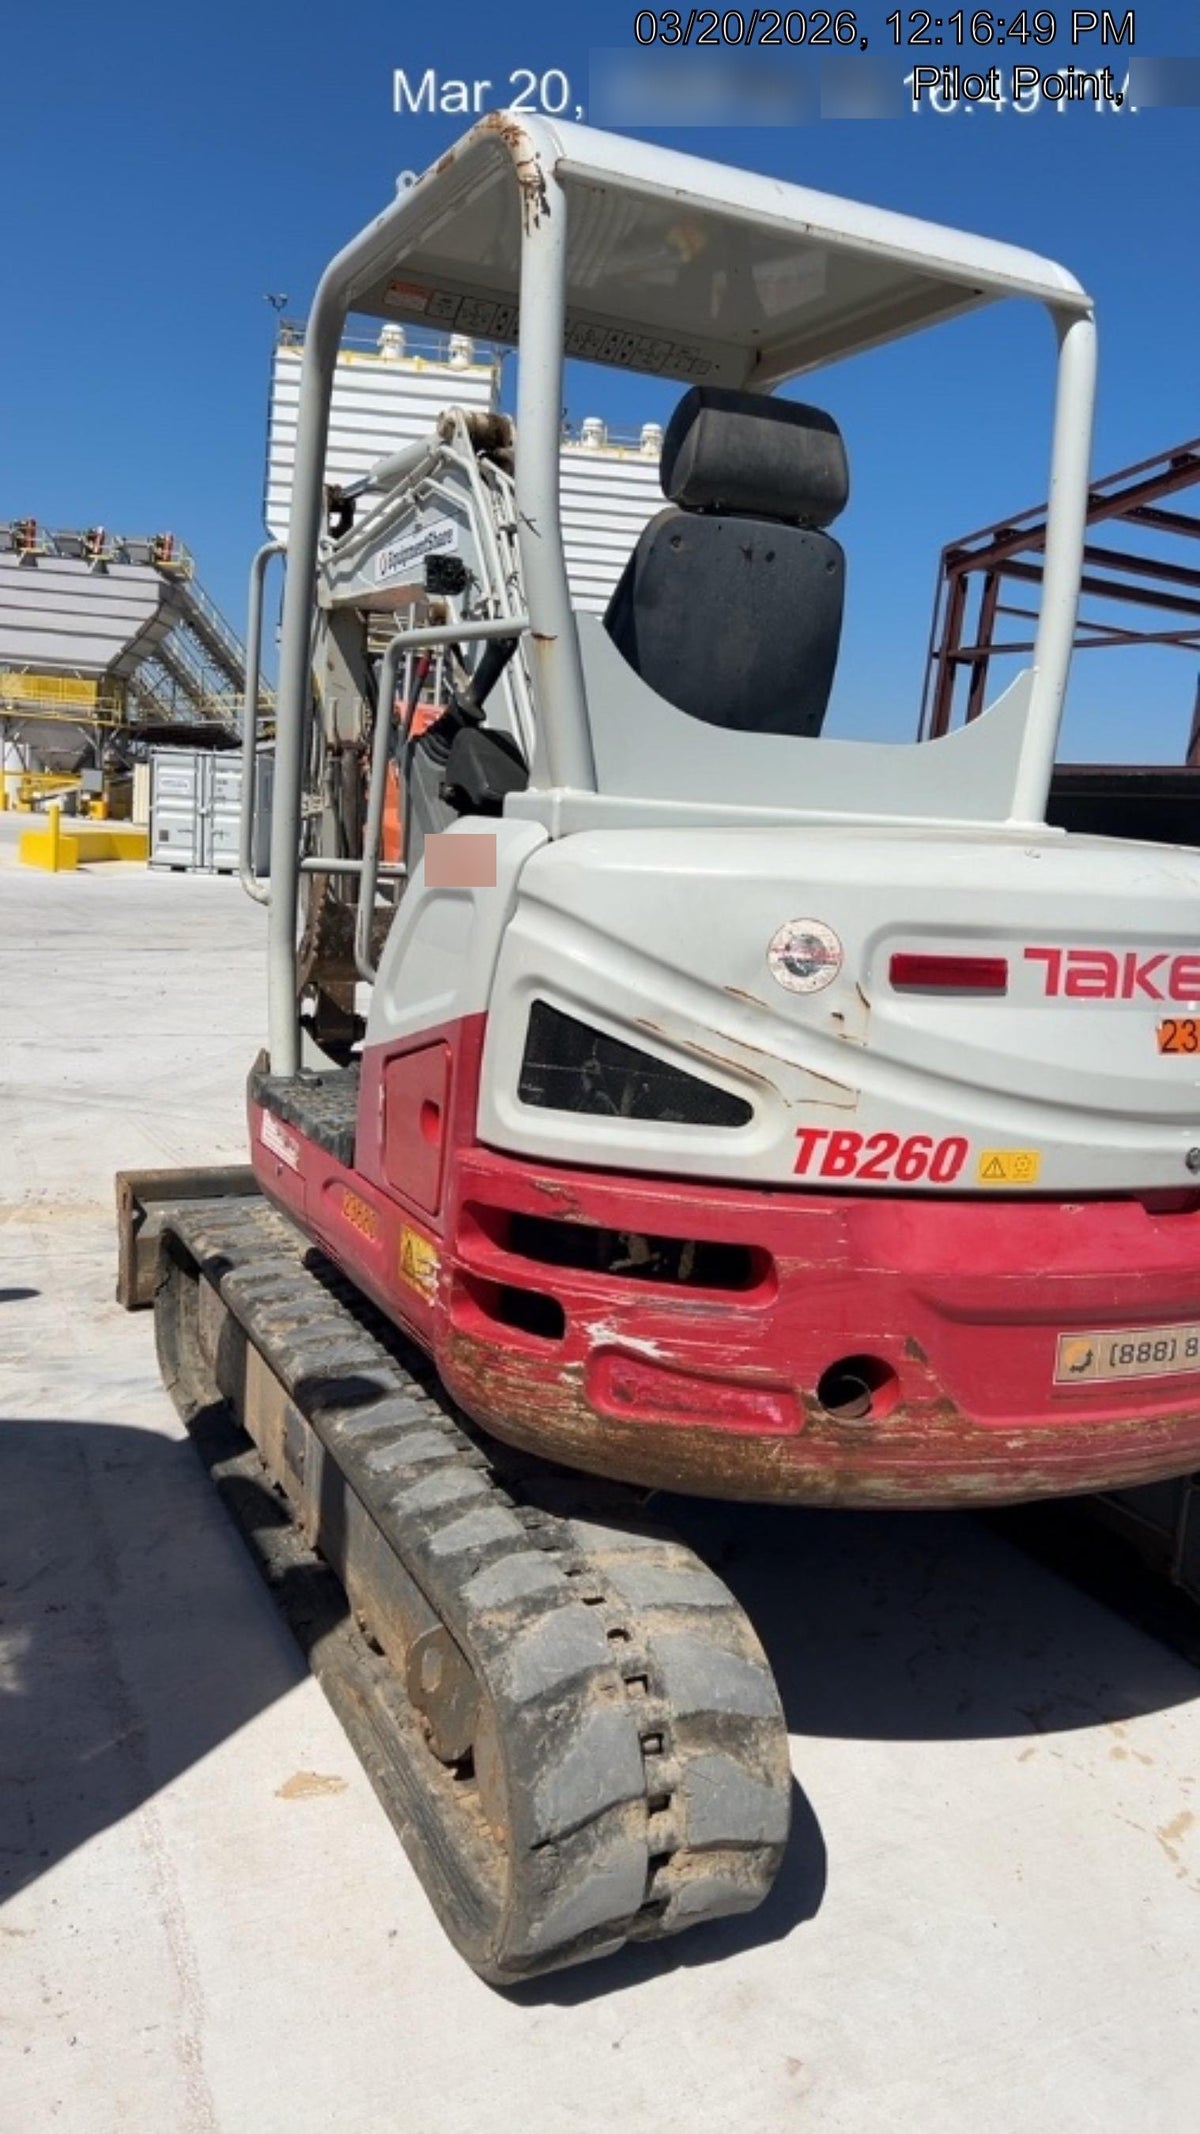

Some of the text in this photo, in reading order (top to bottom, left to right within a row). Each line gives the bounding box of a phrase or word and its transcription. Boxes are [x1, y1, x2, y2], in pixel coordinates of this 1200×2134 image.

[1161, 1019, 1198, 1053] 23
[793, 1128, 968, 1184] TB260
[1110, 1338, 1176, 1368] (888)
